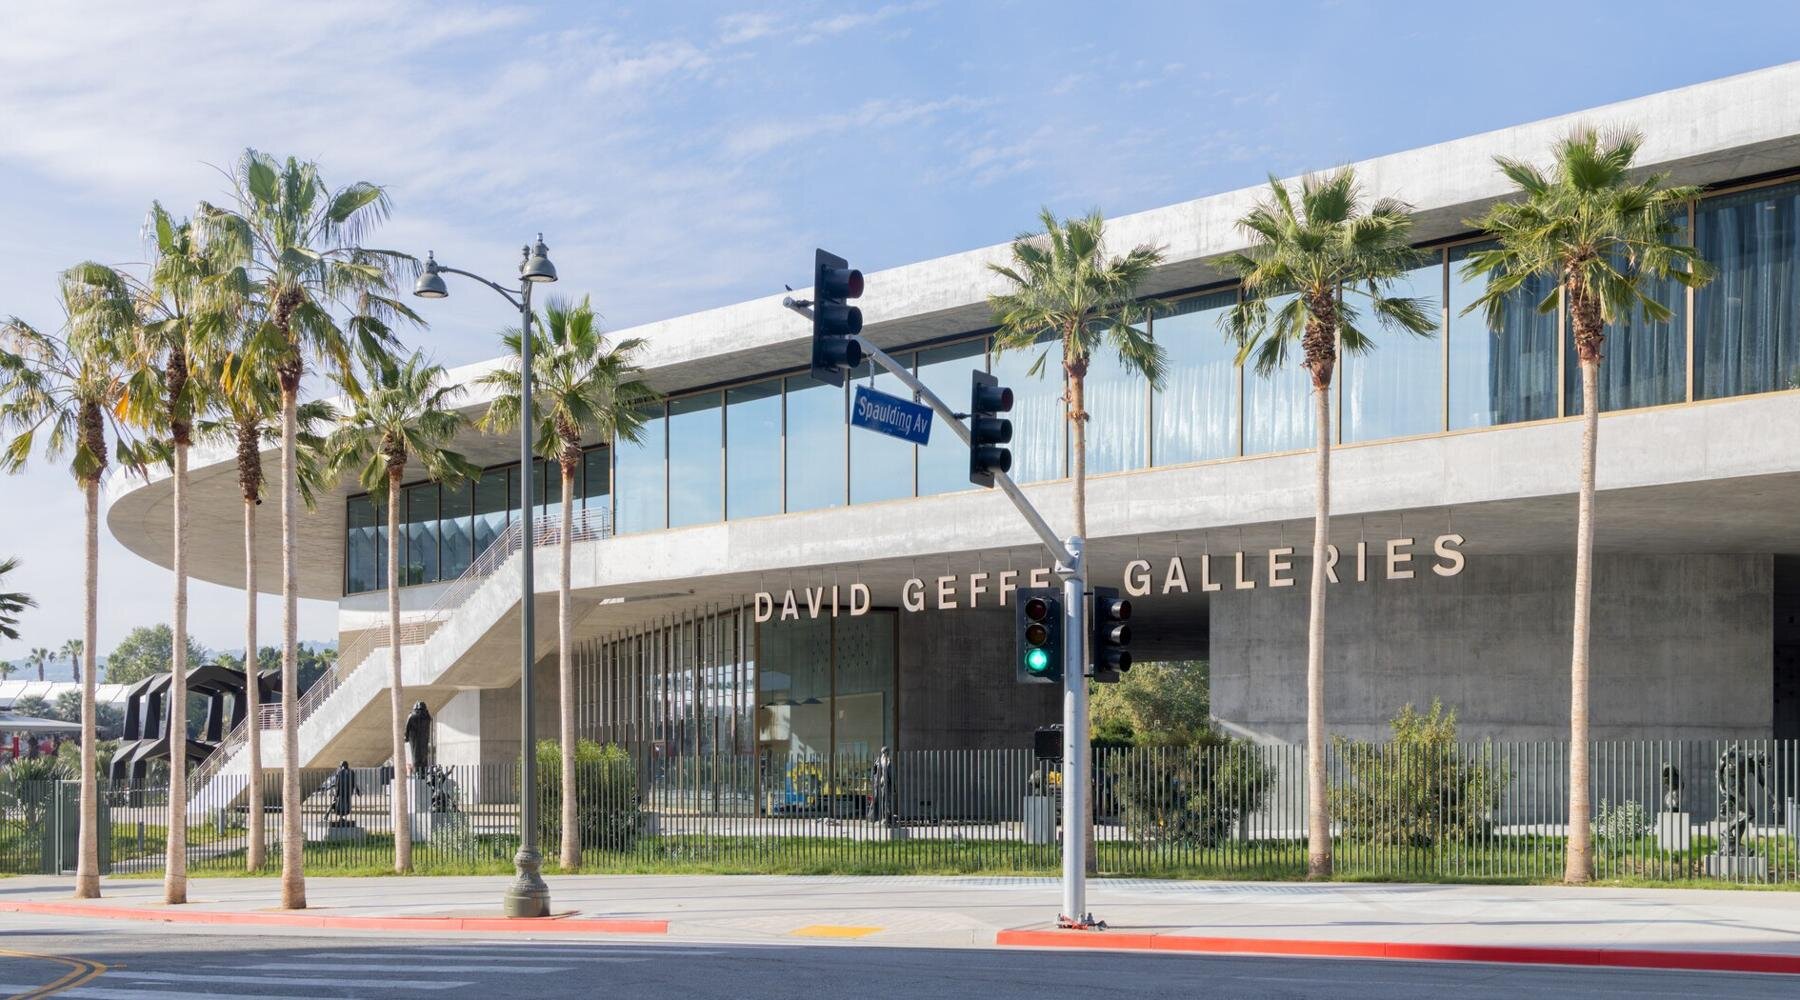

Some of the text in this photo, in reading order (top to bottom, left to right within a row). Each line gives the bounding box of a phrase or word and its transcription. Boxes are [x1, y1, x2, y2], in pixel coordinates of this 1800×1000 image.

[858, 396, 928, 435] Spaulding Av
[754, 583, 871, 623] DAVID
[902, 568, 1052, 613] GEFFE
